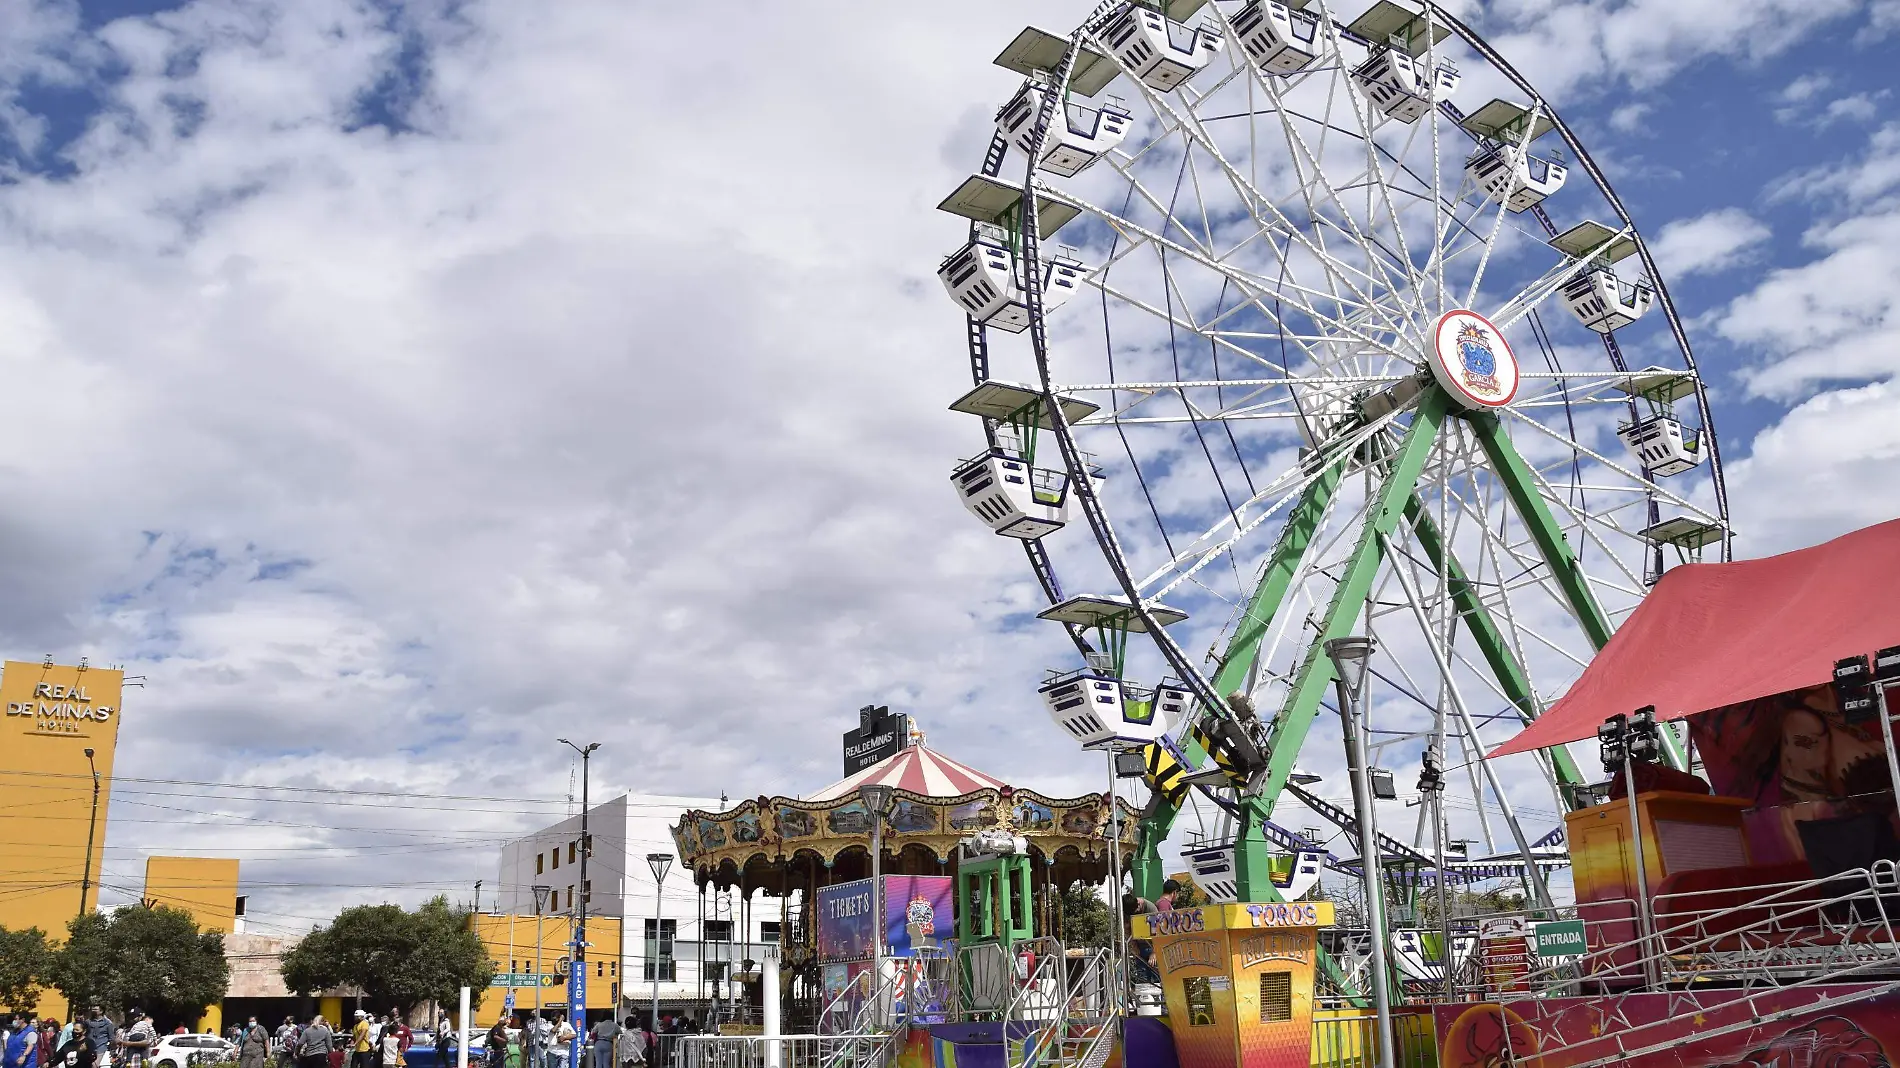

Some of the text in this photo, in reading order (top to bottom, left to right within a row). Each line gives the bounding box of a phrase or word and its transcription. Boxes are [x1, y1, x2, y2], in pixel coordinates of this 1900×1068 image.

[34, 682, 92, 701] REAL
[7, 702, 34, 716] DE
[38, 720, 79, 732] HOTEL
[845, 744, 862, 758] REAL
[862, 741, 871, 751] DE
[860, 754, 879, 766] HOTEL
[829, 892, 870, 919] TICKETS
[1146, 908, 1204, 936] TOROS
[1246, 904, 1317, 927] TOROS
[1245, 935, 1304, 961] BOLETOS
[1540, 932, 1582, 946] ENTRADA
[1165, 941, 1217, 968] BOLETOS
